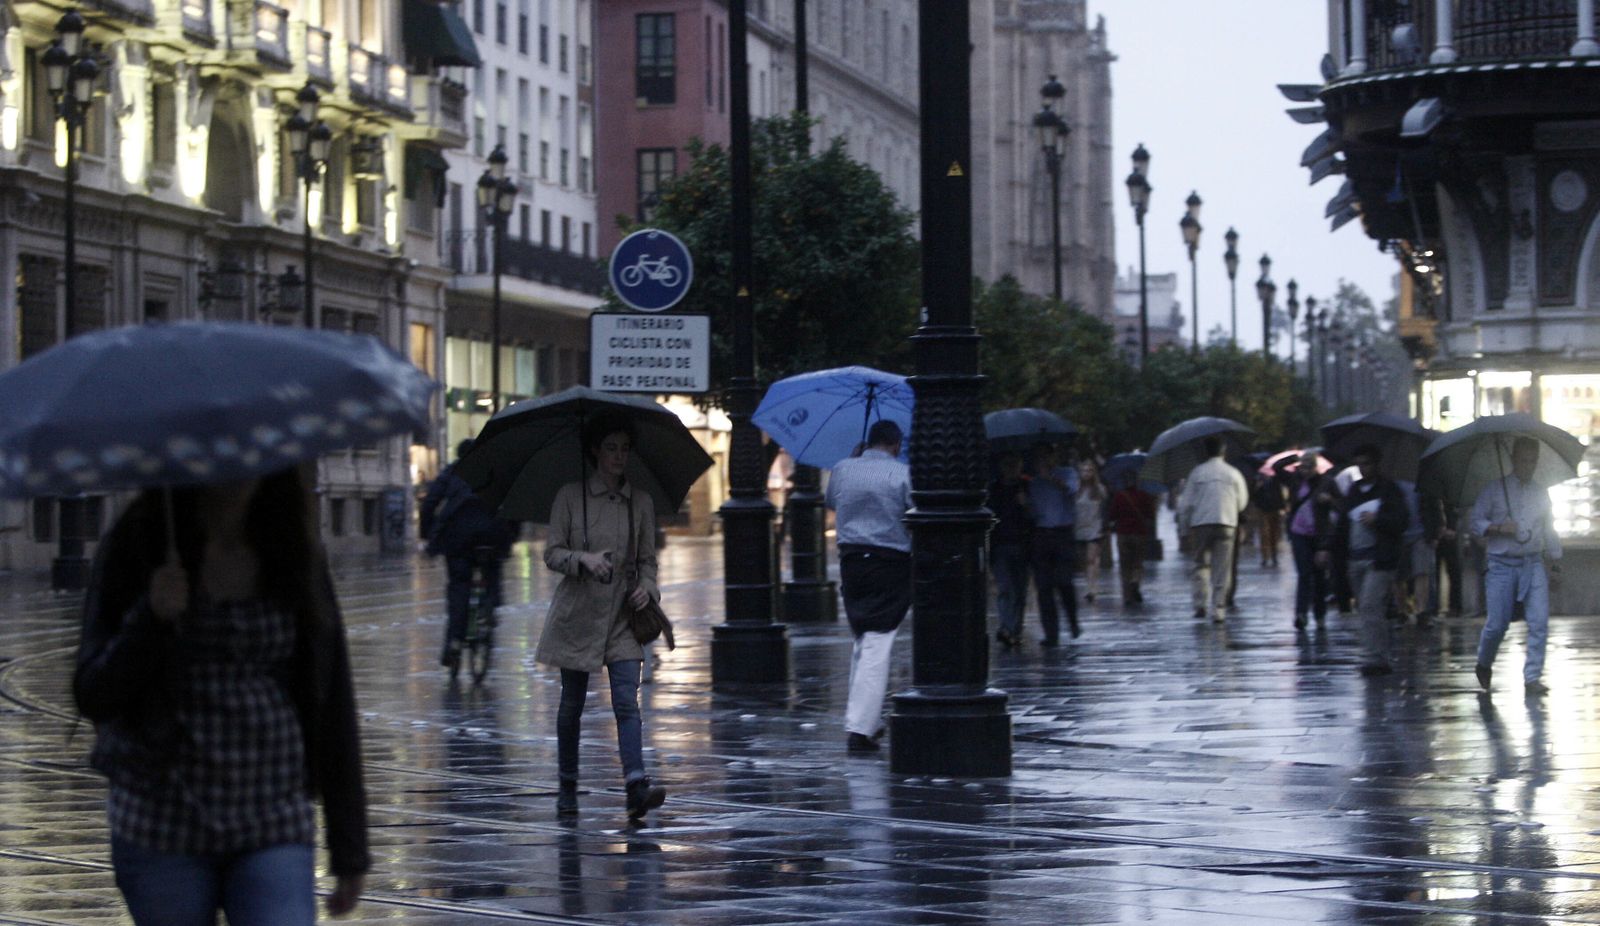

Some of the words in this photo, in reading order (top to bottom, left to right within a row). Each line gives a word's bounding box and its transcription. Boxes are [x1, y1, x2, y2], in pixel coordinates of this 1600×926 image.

[616, 318, 684, 330] ITINERARIO
[609, 337, 663, 349] CICLISTA
[665, 337, 692, 349] CON
[609, 356, 672, 368] PRIORIDAD
[676, 357, 691, 369] DE
[602, 375, 632, 387] PASO
[637, 375, 697, 388] PEATONAL
